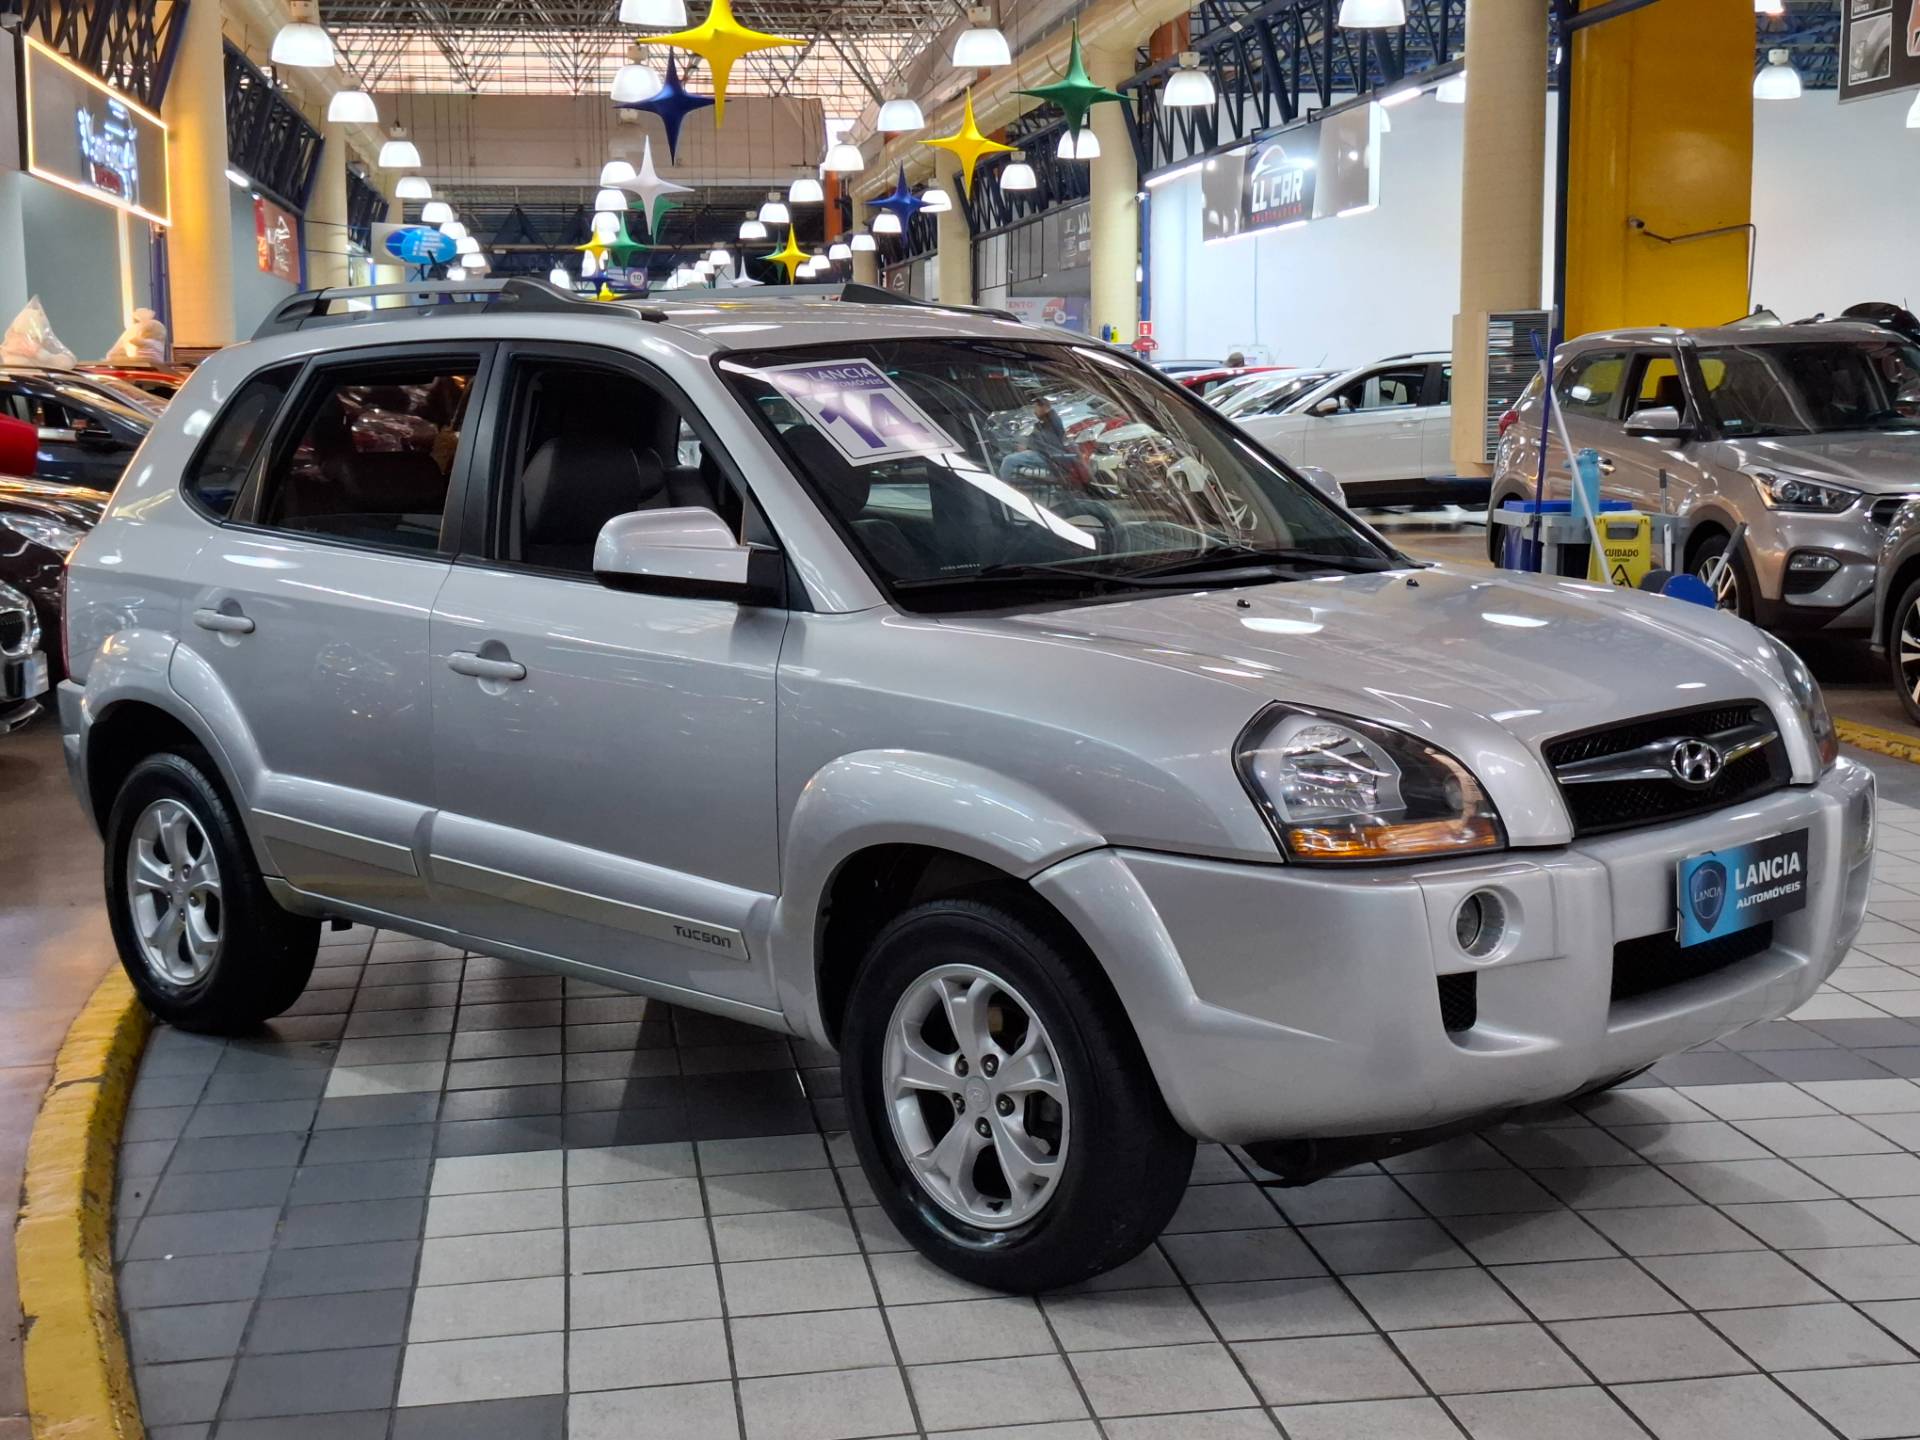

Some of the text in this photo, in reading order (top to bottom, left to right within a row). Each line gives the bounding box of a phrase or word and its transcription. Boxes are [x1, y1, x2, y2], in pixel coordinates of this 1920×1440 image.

[1252, 168, 1303, 213] LL CAR
[806, 367, 877, 381] LANCIA
[820, 393, 931, 449] 14
[1604, 549, 1639, 557] CUIDADO
[1735, 851, 1801, 890] LANCIA
[1694, 886, 1722, 902] LANCIA
[1736, 881, 1801, 909] AUTOMÓVEIS
